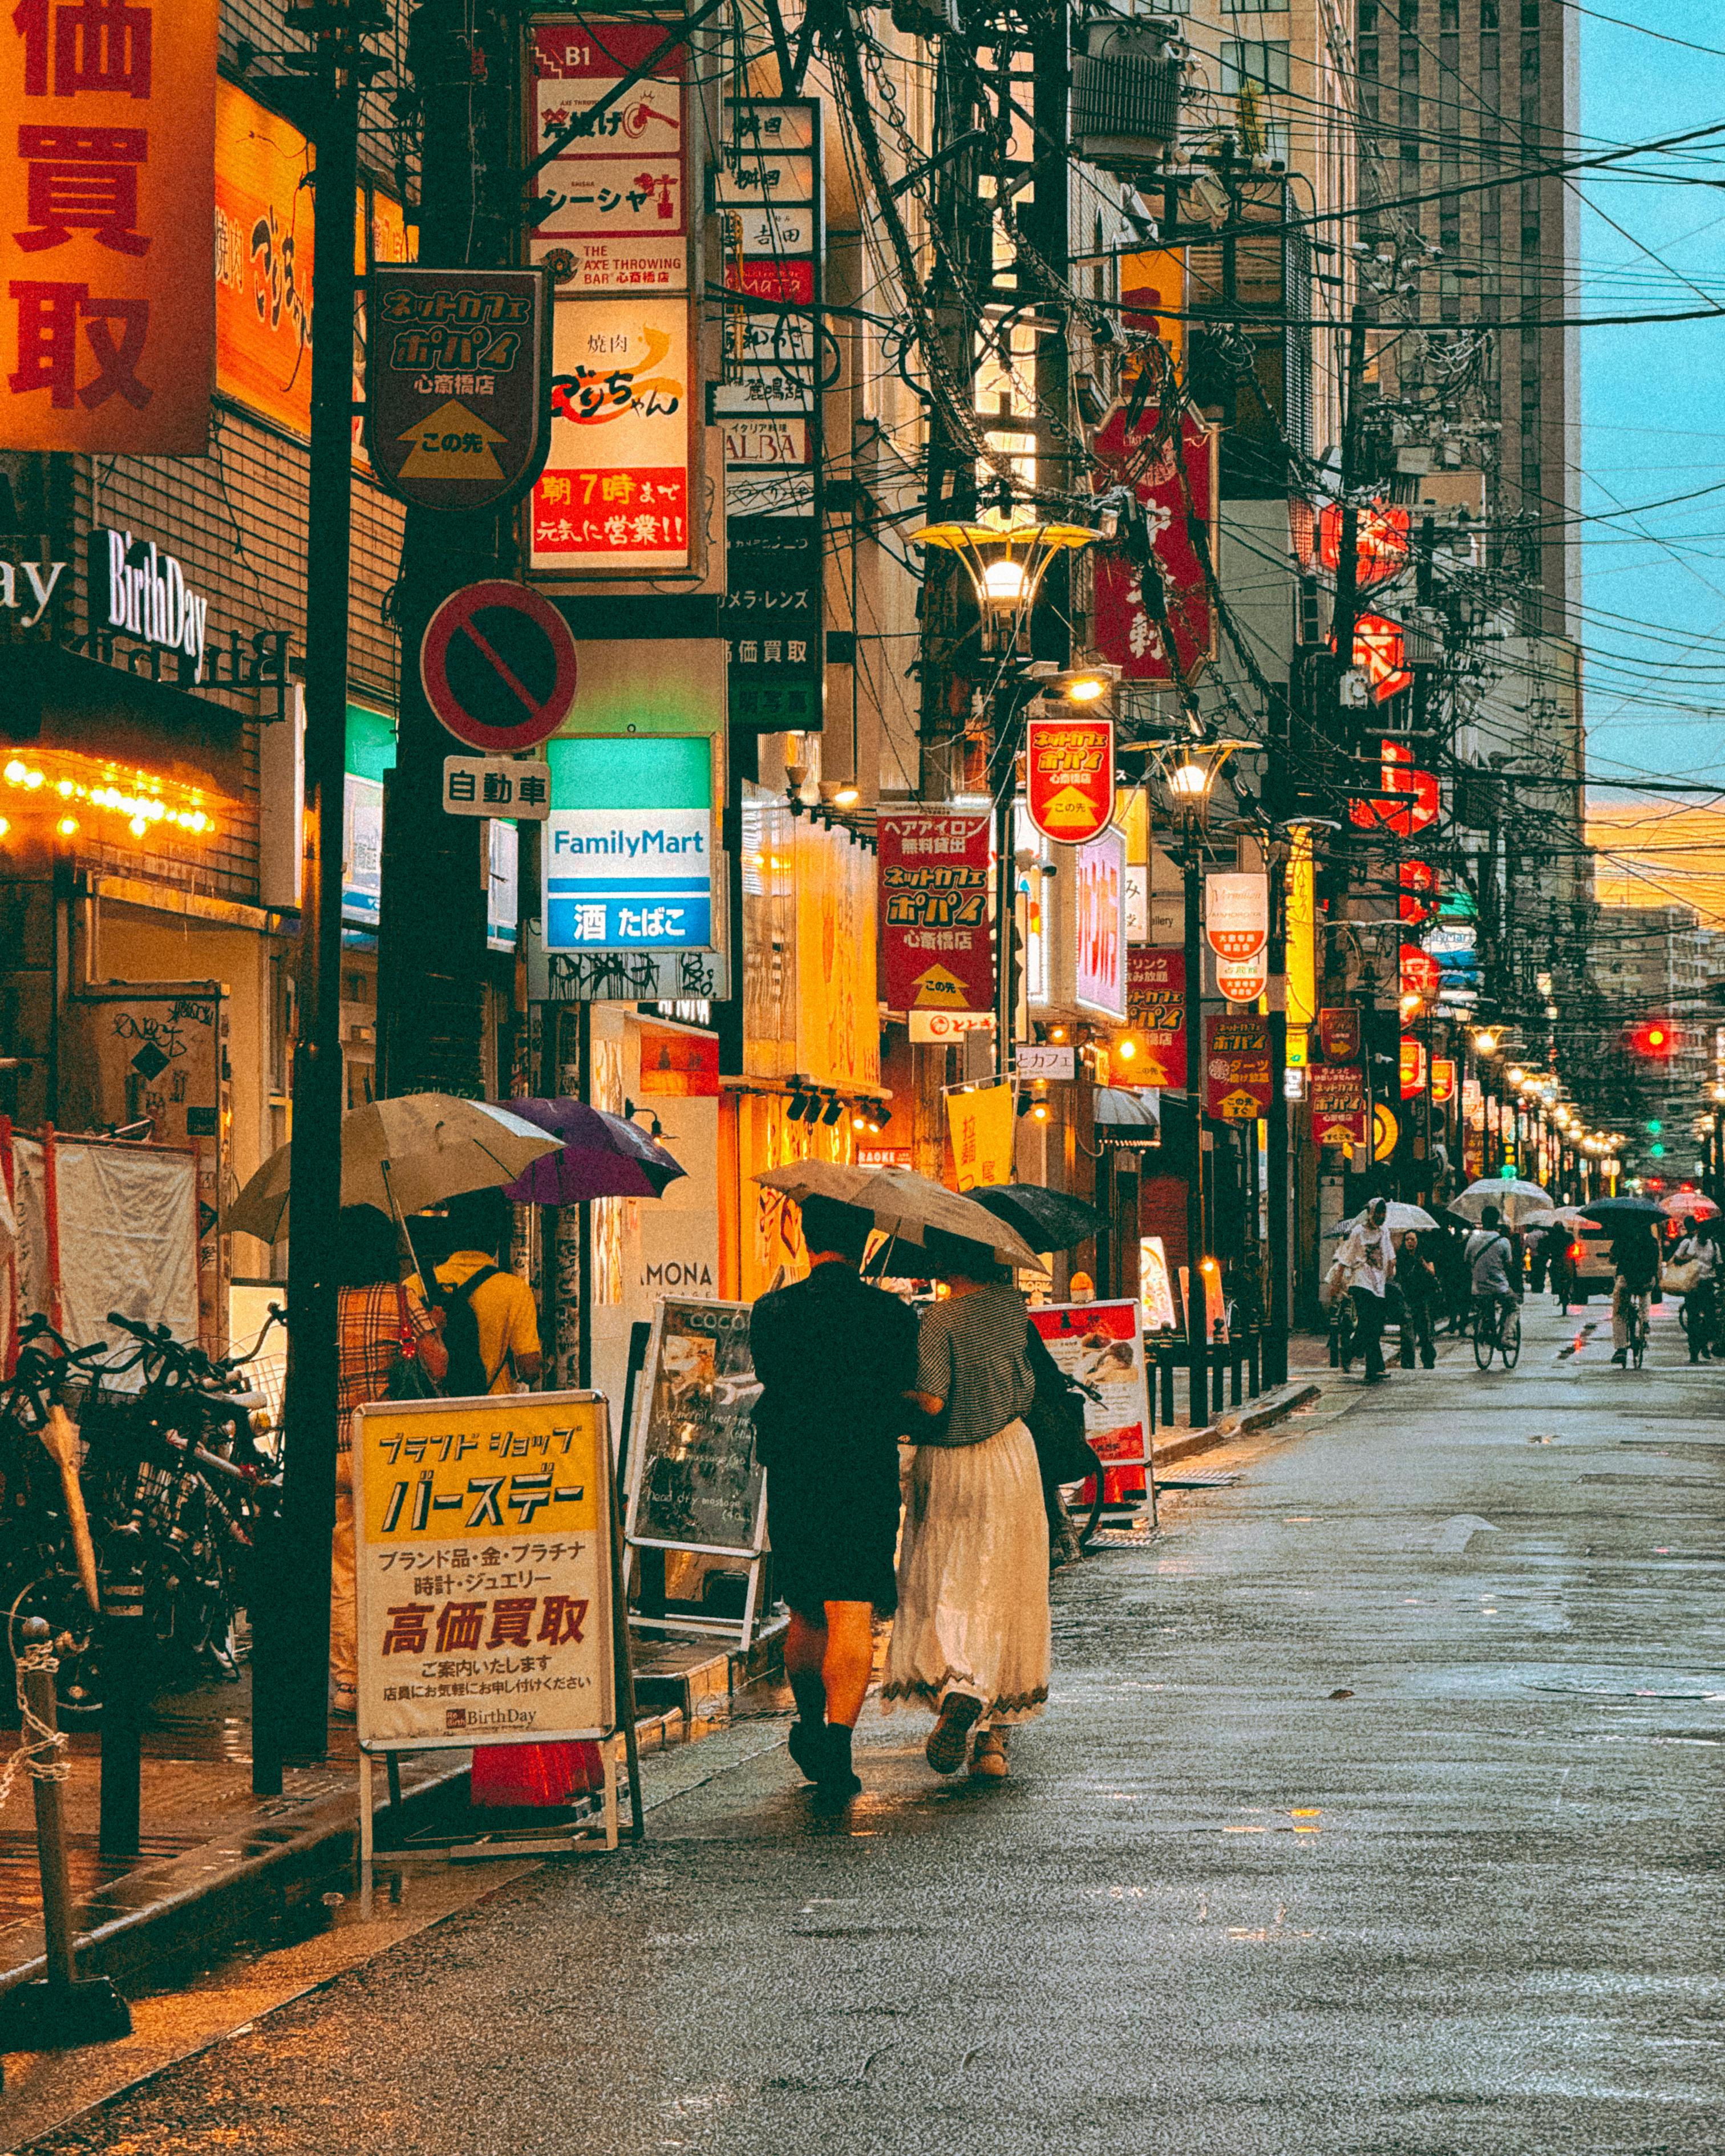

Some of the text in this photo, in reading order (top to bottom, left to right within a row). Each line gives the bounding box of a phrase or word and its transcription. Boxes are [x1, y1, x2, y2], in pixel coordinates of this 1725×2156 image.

[565, 47, 590, 66] B1
[545, 189, 647, 213] シーシャ
[584, 246, 608, 256] THE
[584, 259, 681, 270] AXE THROWING
[584, 274, 609, 284] BAR
[382, 290, 531, 323] ネットカフェ
[394, 327, 519, 370] ポパイ
[587, 334, 628, 353] 焼肉
[414, 374, 495, 395] 心斎橋店
[421, 433, 483, 453] この先
[726, 435, 797, 461] ALBA
[541, 475, 681, 505] 朝7時まで
[108, 529, 208, 684] BirthDay
[1033, 733, 1107, 747] ネットカフェ
[1039, 751, 1103, 771] ポパイ
[449, 770, 546, 806] 自動車
[1055, 803, 1086, 813] この先
[554, 830, 704, 857] FamilyMart
[884, 866, 986, 889] ネットカフェ
[888, 892, 985, 927] ポパイ
[574, 904, 686, 941] 酒 たばこ
[904, 930, 973, 951] 心斎橋店
[925, 980, 957, 994] この先
[1213, 1034, 1268, 1051] ポパイ
[640, 1262, 712, 1286] MONA
[379, 1425, 582, 1465] ブランド ショップ
[381, 1462, 584, 1533] バースデー
[379, 1542, 586, 1571] ブランド品・金・プラチナ
[414, 1570, 552, 1596] 時計・ジュエリー
[382, 1595, 589, 1656] 高価買取
[421, 1655, 552, 1679] ご案内いたします
[383, 1676, 591, 1701] 店員にお気軽にお申し付けください
[468, 1708, 536, 1725] BirthDay
